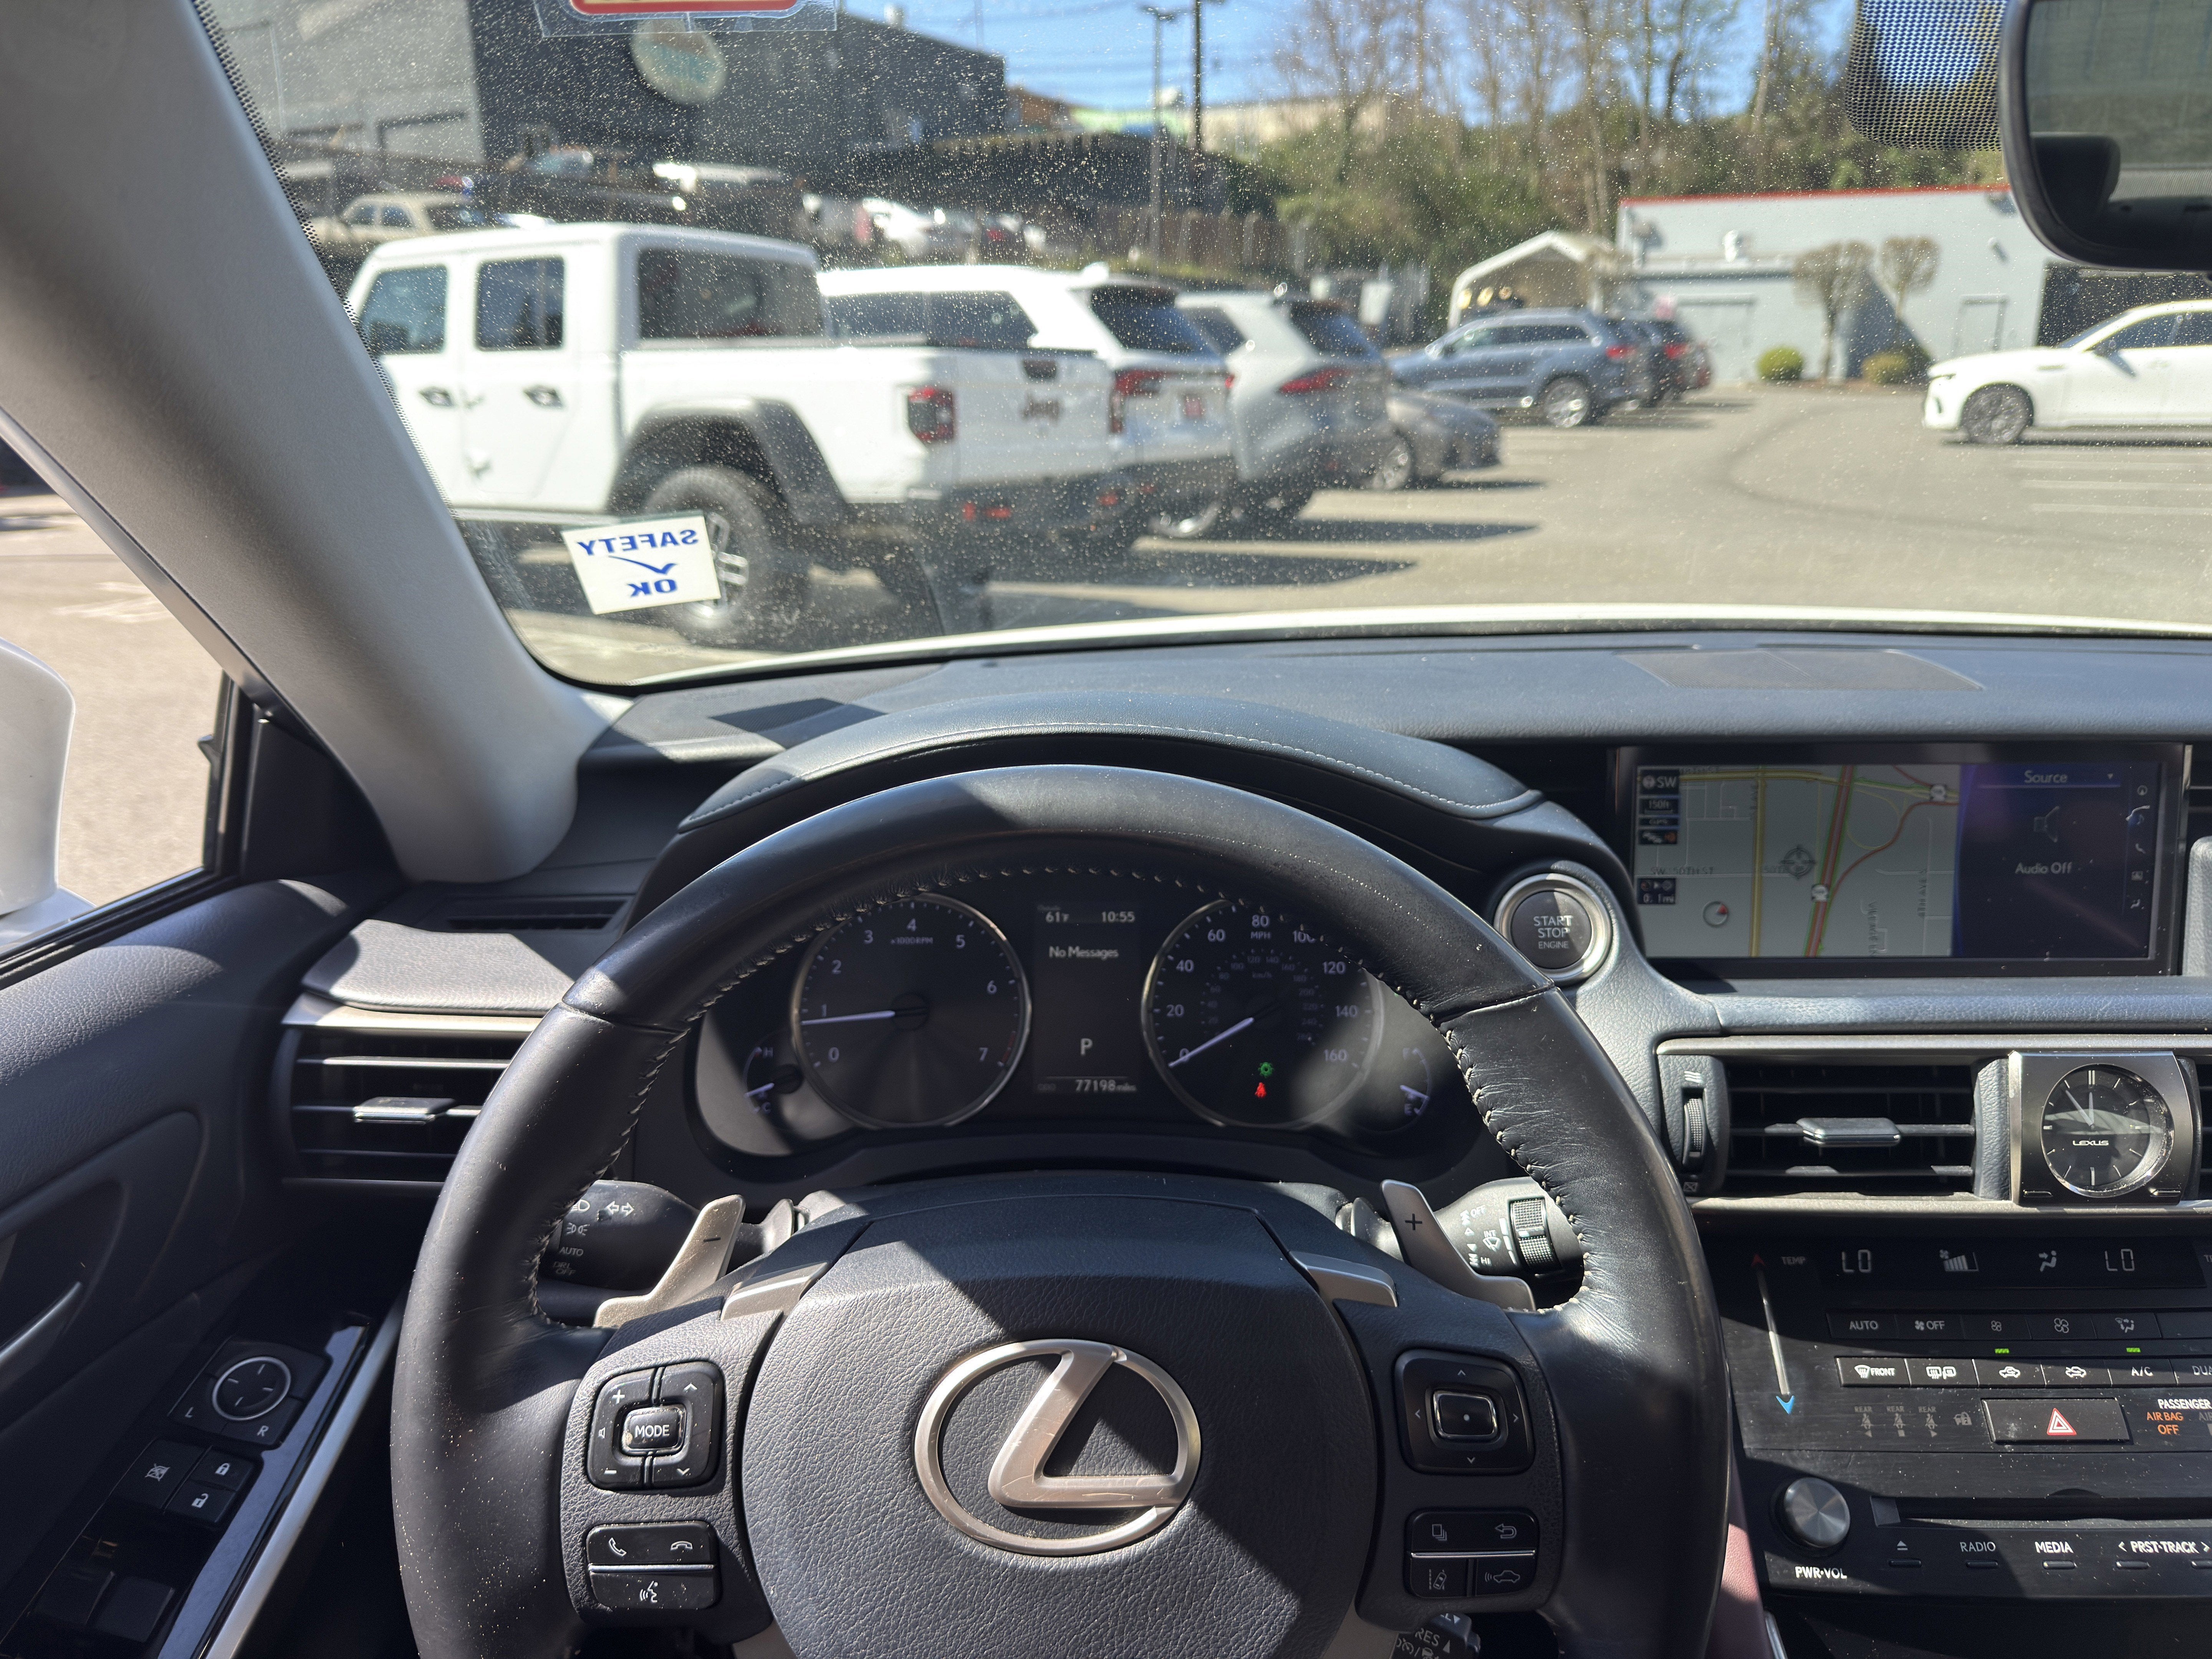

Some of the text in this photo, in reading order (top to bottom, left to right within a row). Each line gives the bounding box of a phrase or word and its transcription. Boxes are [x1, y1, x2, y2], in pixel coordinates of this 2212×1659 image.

[1657, 776, 1677, 788] SW
[2024, 770, 2068, 784] Source
[2015, 862, 2073, 875] Audio Off
[1101, 911, 1136, 923] 10:55
[1252, 915, 1270, 927] 80
[1533, 915, 1573, 926] START
[906, 917, 917, 932] 4
[864, 930, 874, 944] 3
[1207, 930, 1225, 942] 60
[1250, 931, 1271, 940] MPH
[1293, 930, 1316, 944] 100
[1538, 927, 1571, 938] STOP
[956, 934, 966, 949] 5
[1538, 941, 1569, 949] ENGINE
[1049, 946, 1119, 960] No Messages
[832, 960, 842, 974] 2
[1176, 959, 1194, 973] 40
[1323, 961, 1346, 975] 120
[987, 980, 997, 994] 6
[821, 1004, 827, 1017] 1
[1167, 1004, 1185, 1017] 20
[1335, 1005, 1358, 1018] 140
[1080, 1038, 1093, 1055] P
[828, 1047, 839, 1062] 0
[979, 1047, 989, 1062] 7
[1324, 1049, 1348, 1063] 160
[1075, 1079, 1116, 1092] 77198
[1470, 1205, 1486, 1218] OFF
[559, 1247, 584, 1256] AUTO
[1480, 1257, 1492, 1267] HI
[1781, 1256, 1806, 1265] TEMP
[1842, 1249, 1872, 1273] LO
[2104, 1248, 2135, 1272] LO
[1849, 1320, 1879, 1330] AUTO
[1926, 1321, 1945, 1330] OFF
[1871, 1368, 1896, 1377] FRONT
[2131, 1366, 2154, 1377] A/C
[2157, 1399, 2212, 1409] PASSENGER
[184, 1406, 194, 1419] L
[2147, 1411, 2184, 1421] AIR BAG
[257, 1424, 269, 1437] R
[634, 1424, 670, 1438] MODE
[2157, 1424, 2179, 1435] OFF
[1960, 1541, 1996, 1553] RADIO
[2035, 1541, 2074, 1554] MEDIA
[1415, 1628, 1440, 1647] RES
